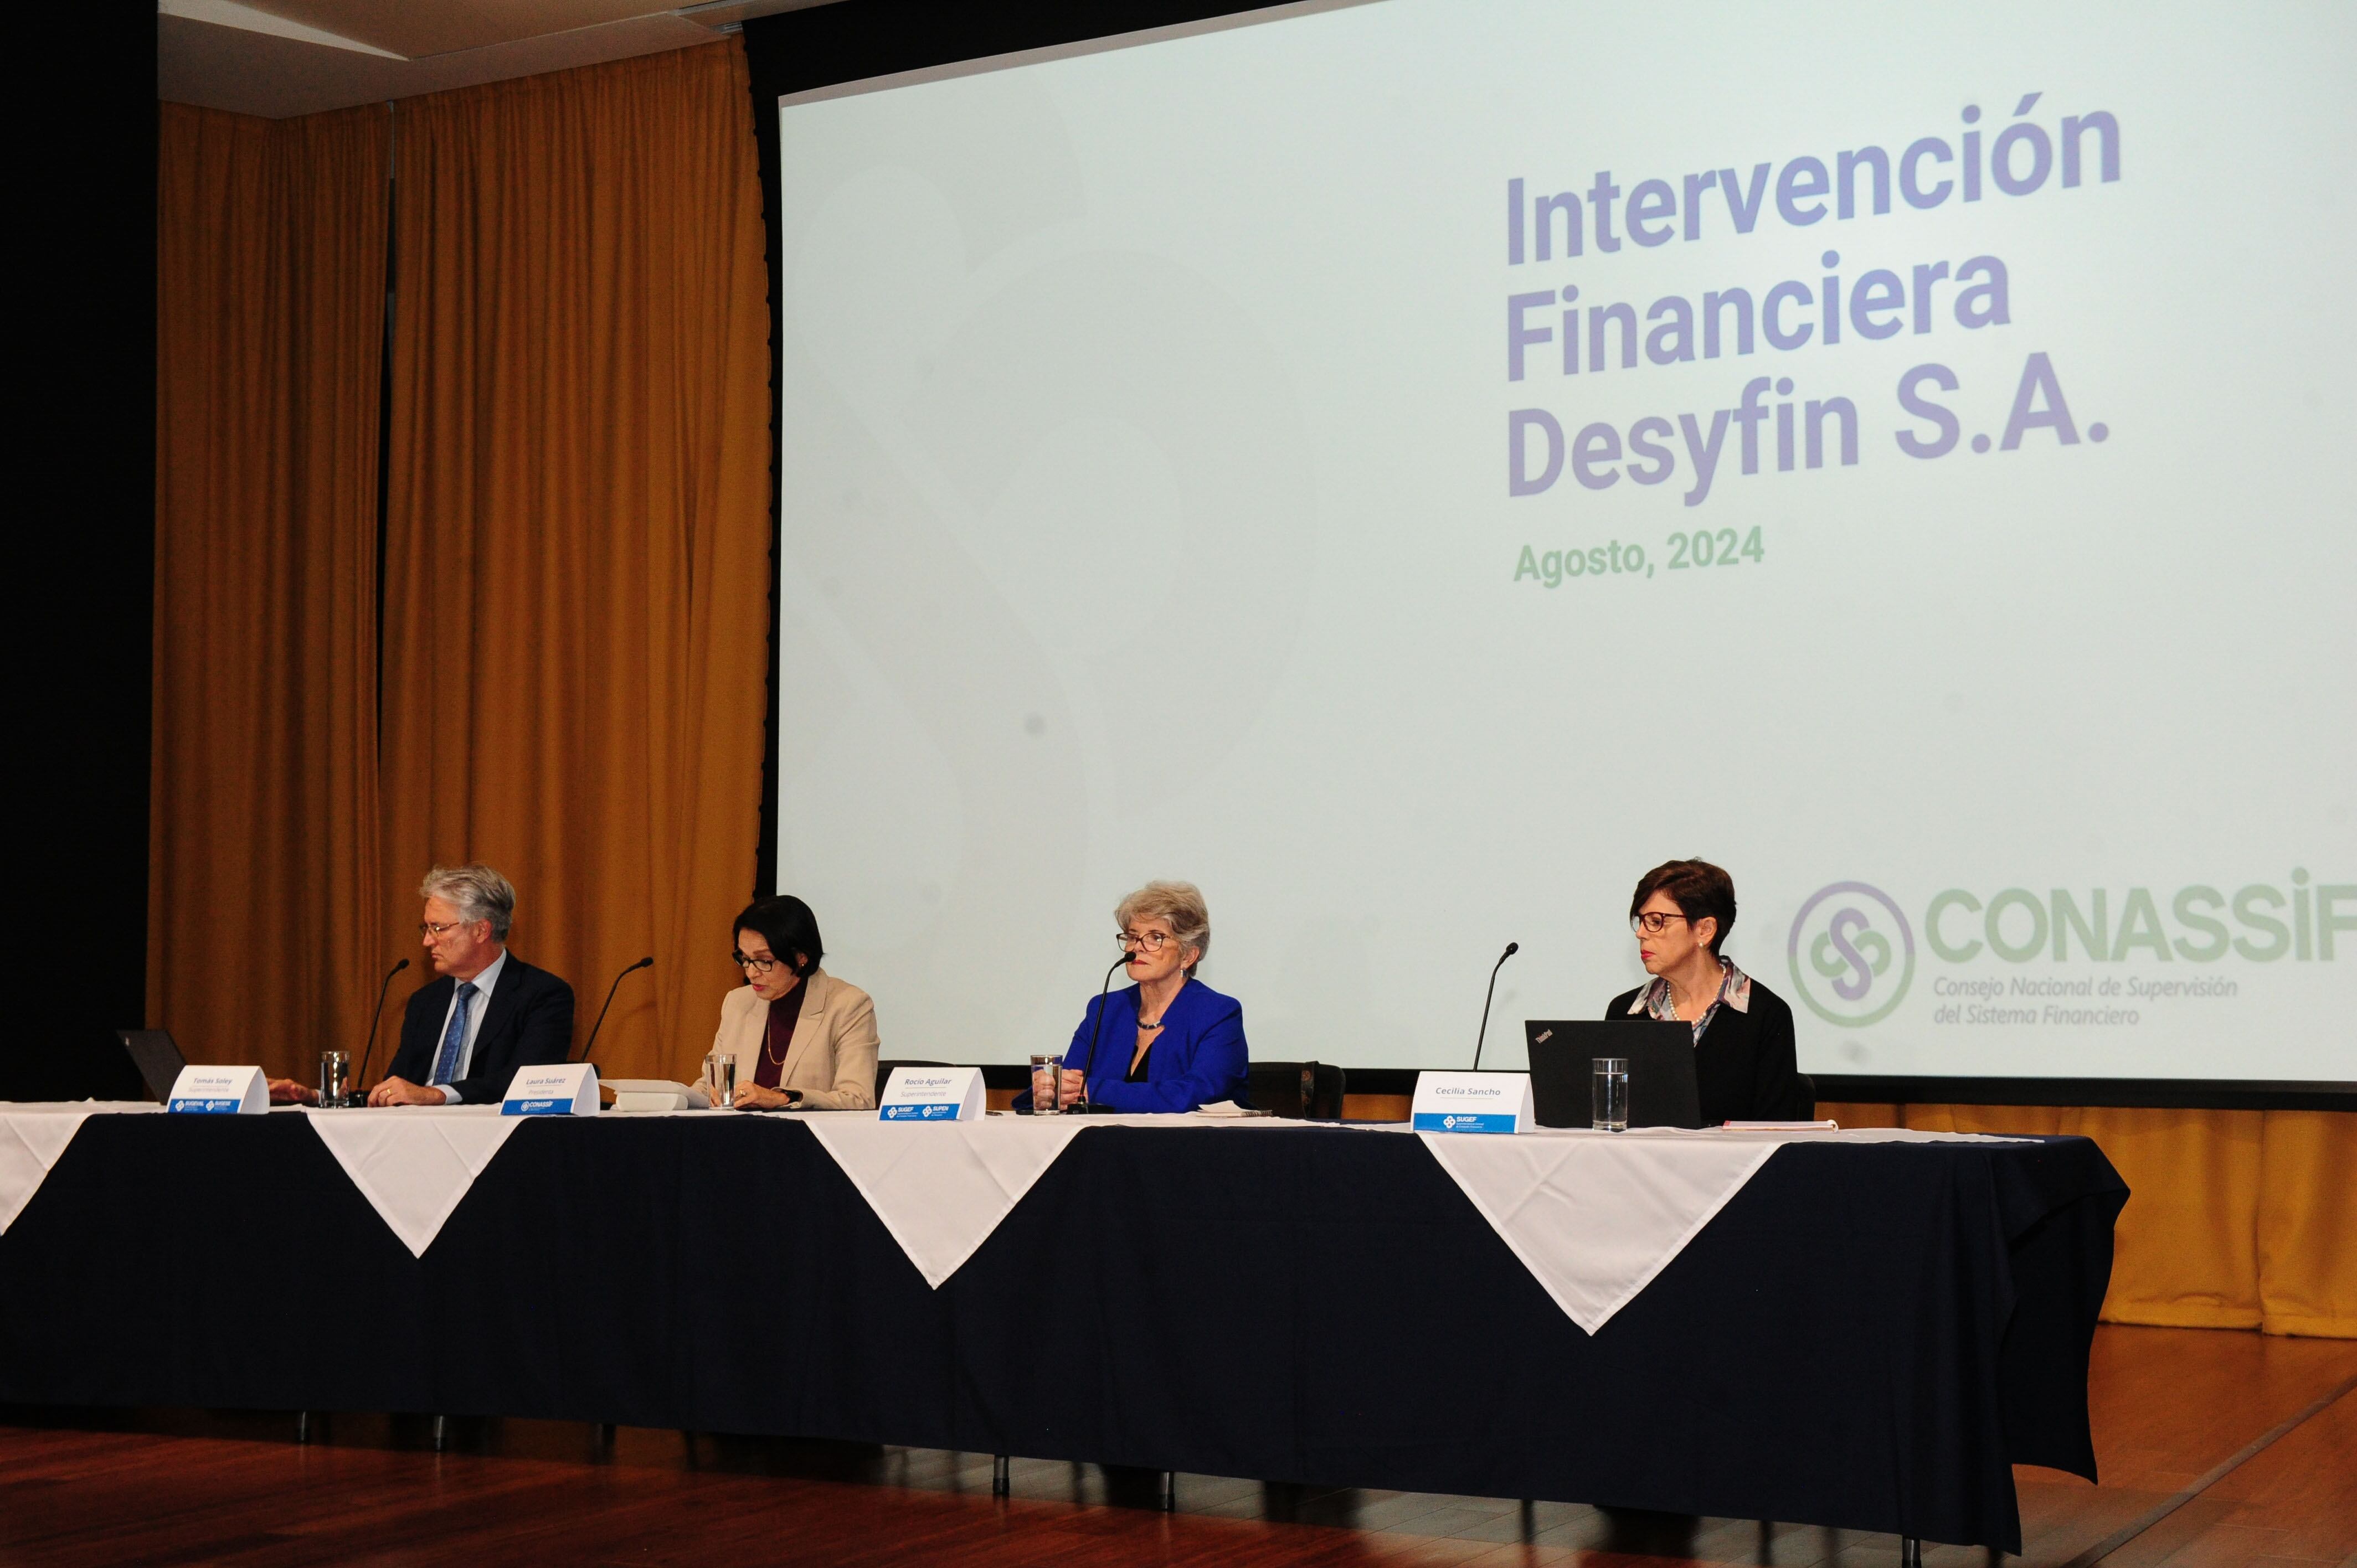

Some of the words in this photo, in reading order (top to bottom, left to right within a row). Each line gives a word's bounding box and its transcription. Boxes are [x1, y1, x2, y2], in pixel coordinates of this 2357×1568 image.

[1507, 91, 2122, 266] Intervención
[1507, 249, 2011, 382] Financiera
[1507, 376, 1860, 508] Desyfin
[1894, 351, 2109, 460] S.A.
[1514, 539, 1654, 589] Agosto,
[1667, 525, 1765, 570] 2024
[1933, 977, 2004, 1001] Consejo
[2010, 977, 2092, 997] Nacional
[2098, 977, 2121, 997] de
[2126, 976, 2238, 1001] Supervisión
[1934, 1004, 1961, 1024] del
[1967, 1004, 2036, 1024] Sistema
[2042, 1005, 2139, 1025] Financiero
[925, 1078, 952, 1086] Aguilar
